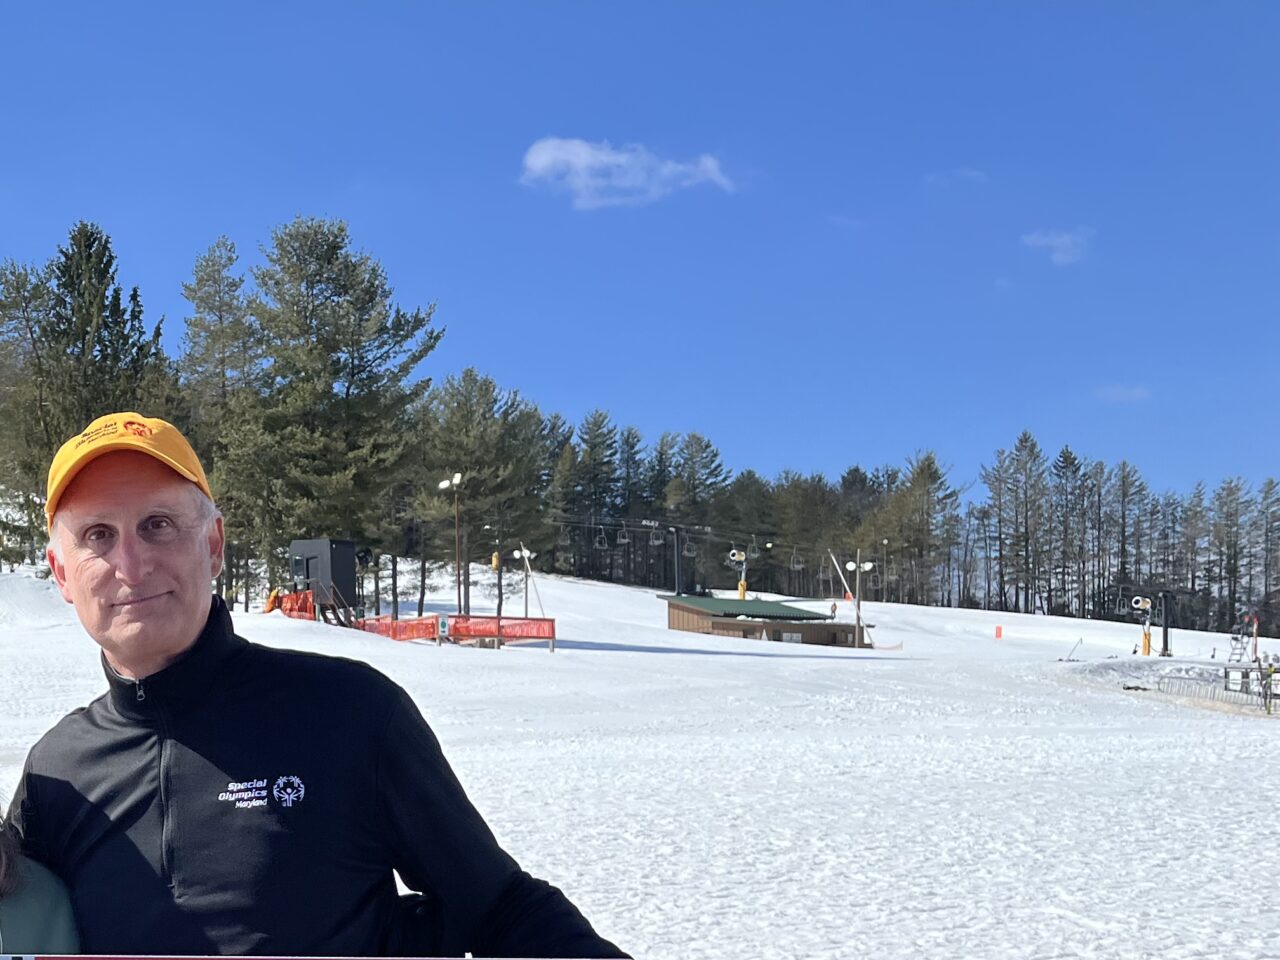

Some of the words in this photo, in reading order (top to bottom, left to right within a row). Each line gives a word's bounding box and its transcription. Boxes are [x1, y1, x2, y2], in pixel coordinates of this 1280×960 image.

[228, 779, 267, 791] Special
[218, 789, 268, 801] Olympics
[235, 798, 268, 808] Maryland
